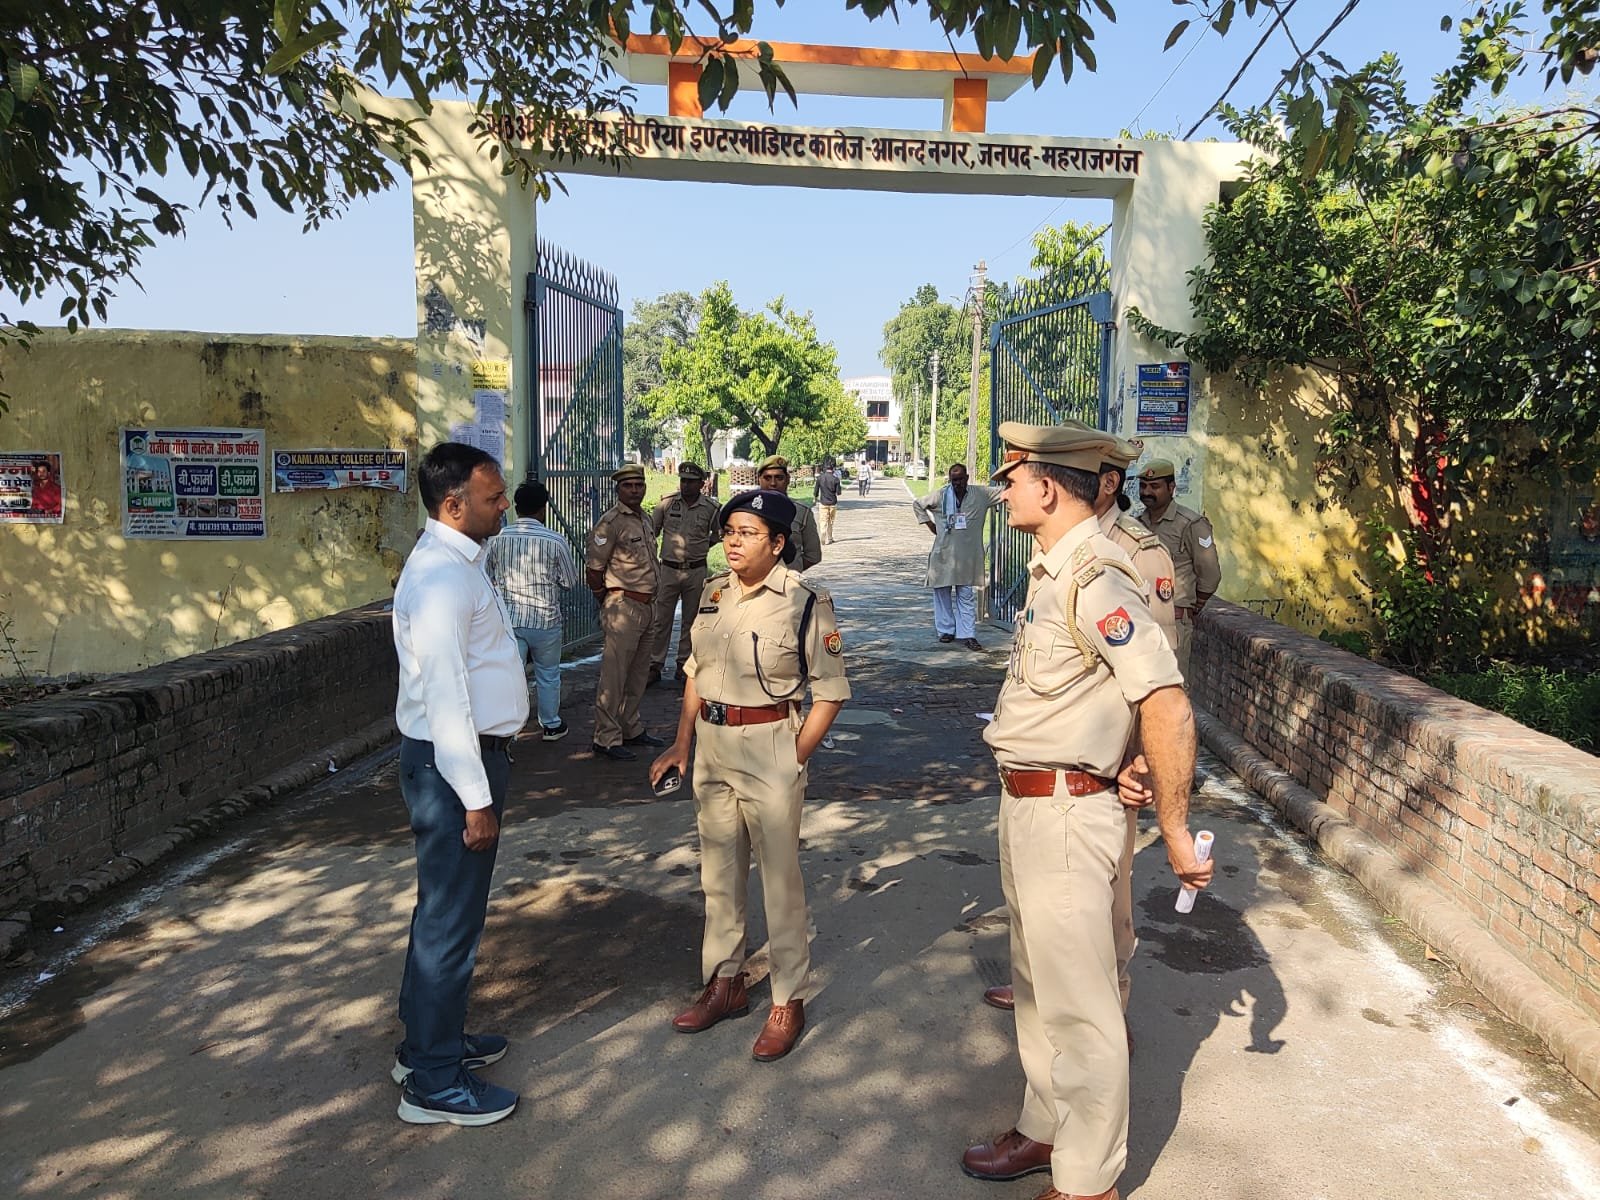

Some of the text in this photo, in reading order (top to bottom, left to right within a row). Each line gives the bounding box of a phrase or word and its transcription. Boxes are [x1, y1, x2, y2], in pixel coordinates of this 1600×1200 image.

[149, 439, 169, 455] राजीव
[291, 454, 339, 465] KAMLARAJE
[341, 454, 374, 465] COLLEGE
[143, 496, 172, 507] CAMPUS
